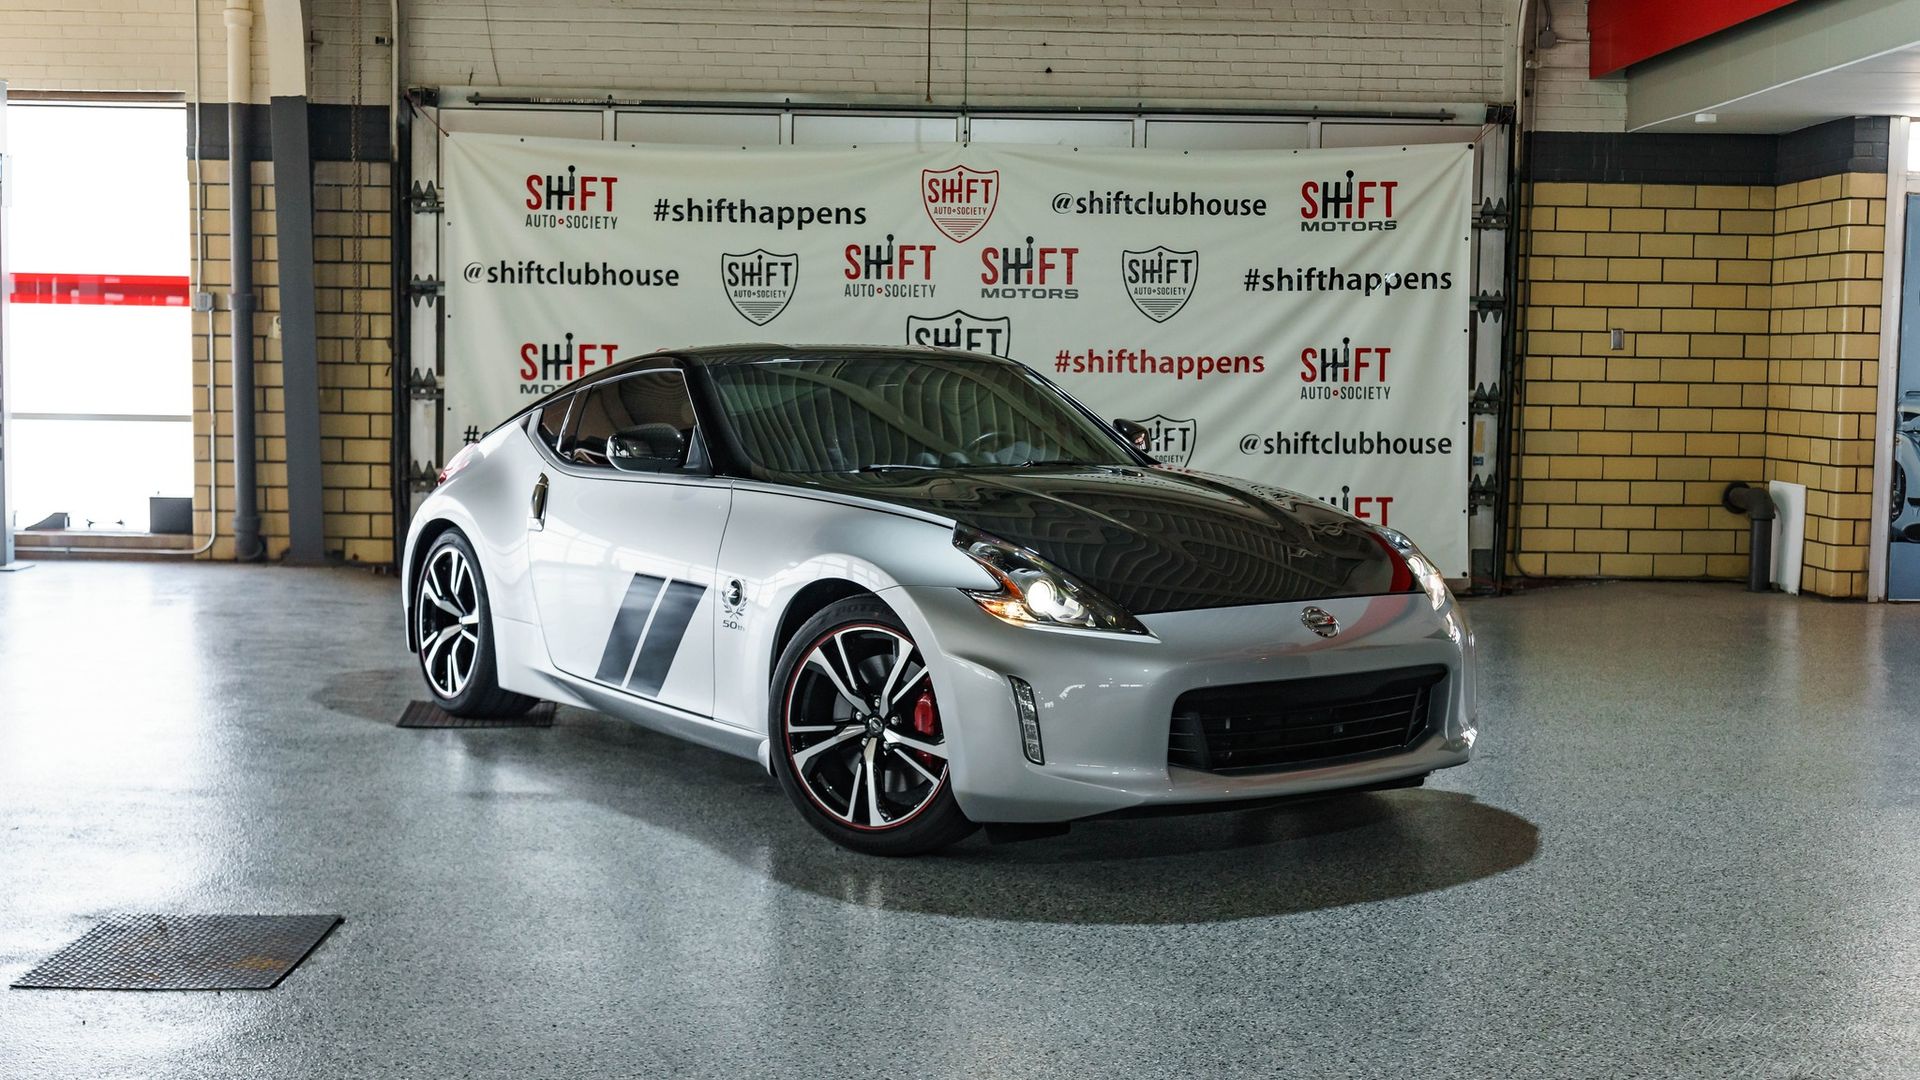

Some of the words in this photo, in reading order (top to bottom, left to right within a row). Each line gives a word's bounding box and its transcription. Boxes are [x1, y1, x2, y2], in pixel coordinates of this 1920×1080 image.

[526, 165, 618, 211] SHIFT
[928, 171, 992, 204] SHIFT
[1052, 191, 1266, 216] @shiftclubhouse
[1301, 170, 1398, 219] SHIFT
[654, 198, 866, 230] #shifthappens
[1301, 220, 1397, 231] MOTORS
[464, 260, 679, 286] @shiftclubhouse
[728, 255, 793, 287] SHIFT
[845, 234, 936, 280] SHIFT
[981, 236, 1079, 285] SHIFT
[1128, 252, 1191, 284] SHIFT
[982, 288, 1078, 299] MOTORS
[1244, 267, 1451, 296] #shifthappens
[1055, 349, 1264, 380] #shifthappens
[1301, 337, 1391, 382] SHIFT
[1239, 431, 1452, 455] @shiftclubhouse
